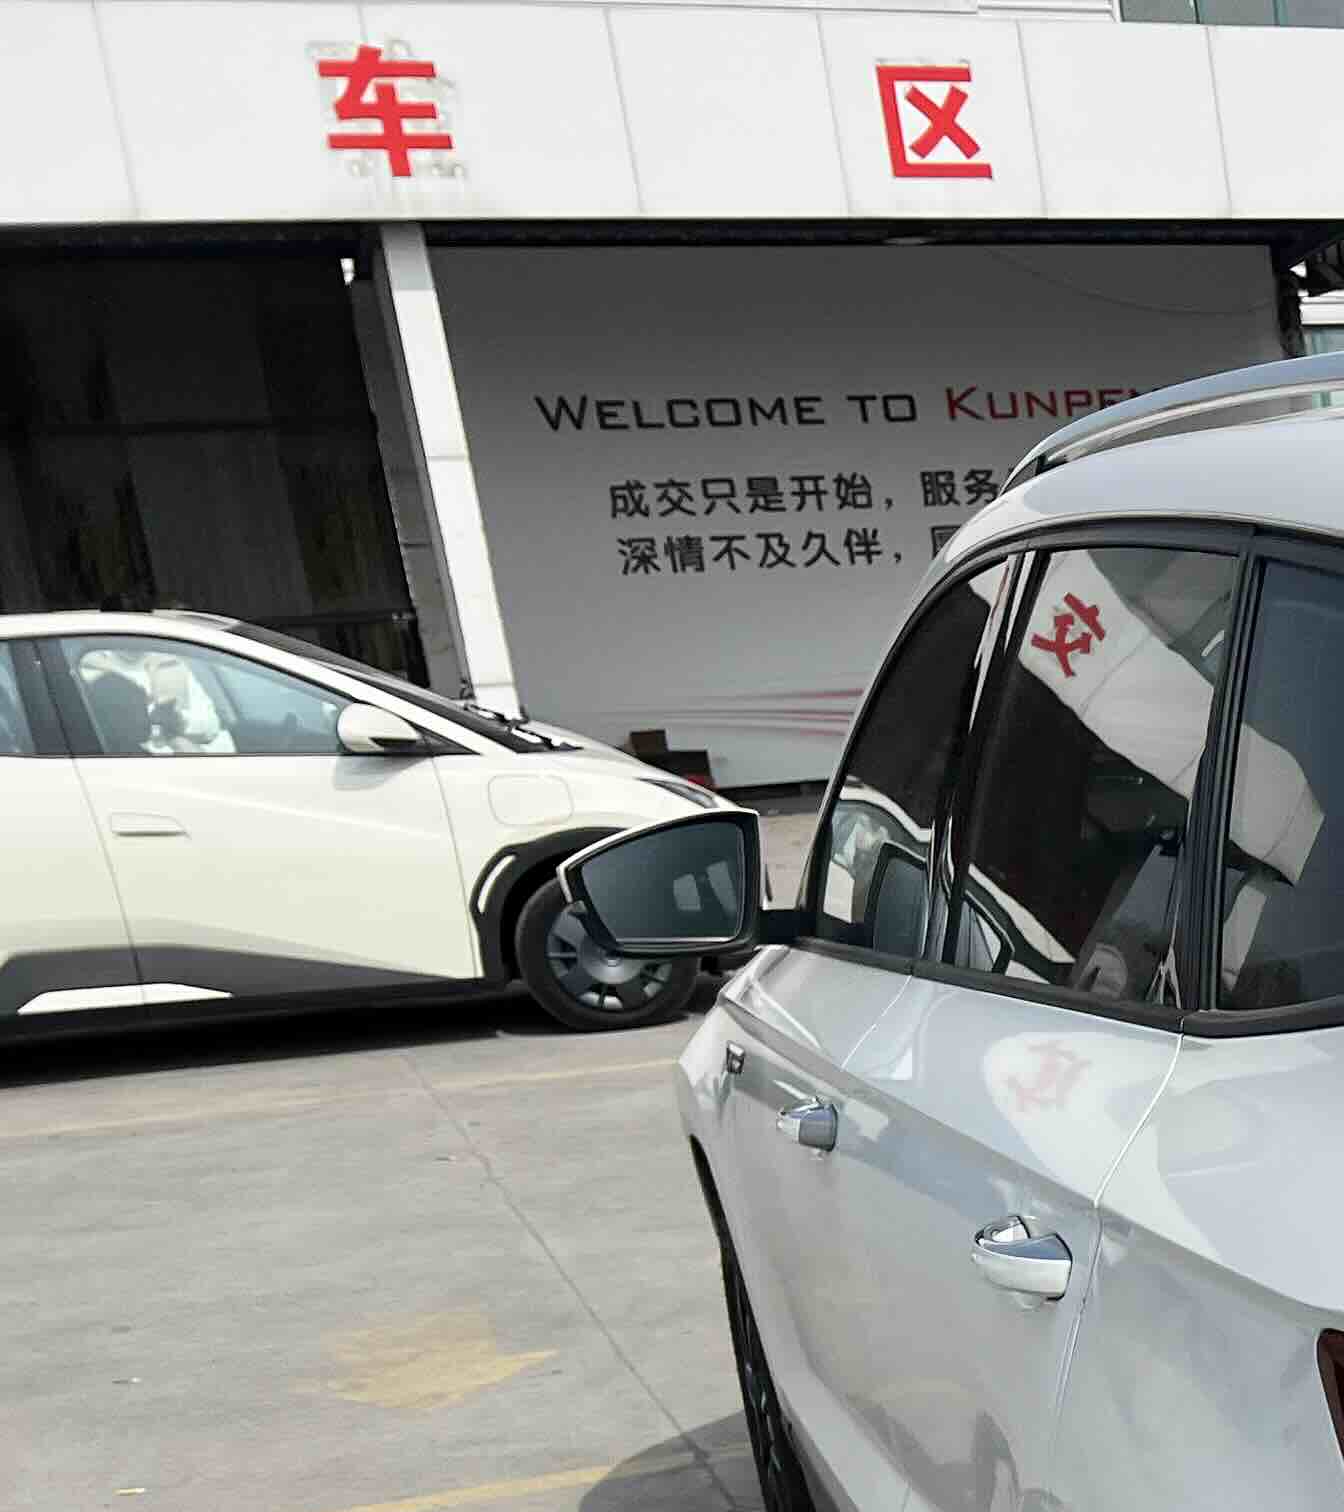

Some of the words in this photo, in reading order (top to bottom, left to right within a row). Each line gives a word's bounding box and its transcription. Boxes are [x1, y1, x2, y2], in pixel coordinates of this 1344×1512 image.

[316, 43, 454, 178] 车
[874, 64, 993, 179] 区
[535, 393, 825, 431] WELCOME
[848, 392, 918, 424] TO
[945, 384, 1140, 420] KUNPE
[609, 467, 1012, 519] 成交只是开始，服务
